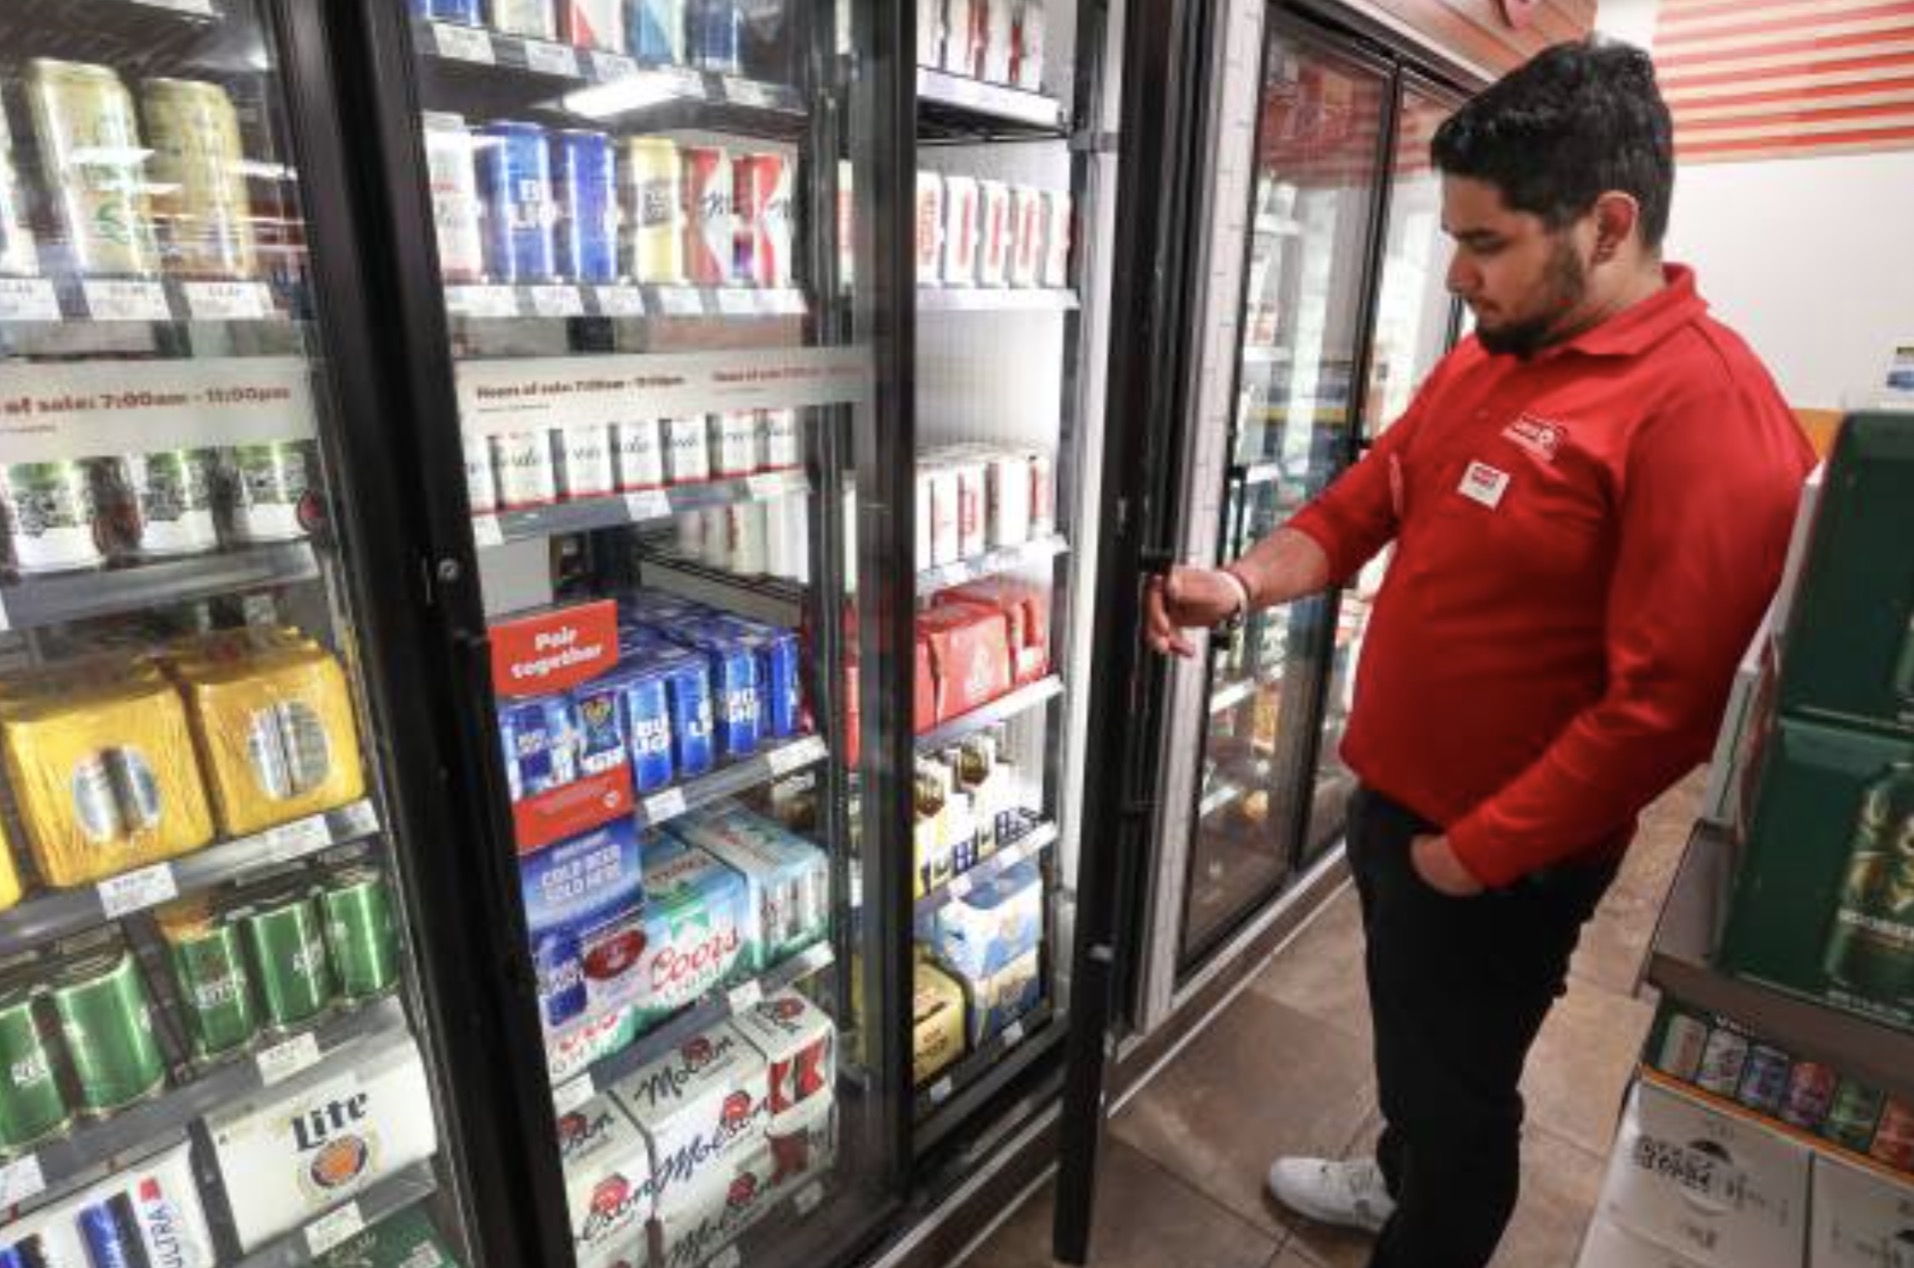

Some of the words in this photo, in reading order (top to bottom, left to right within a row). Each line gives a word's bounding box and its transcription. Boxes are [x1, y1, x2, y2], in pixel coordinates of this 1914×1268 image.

[38, 395, 95, 412] sale:
[99, 392, 188, 409] 7:00am
[206, 386, 291, 402] 11:00pm
[534, 626, 578, 652] Pair
[510, 642, 602, 679] together
[650, 927, 738, 993] Coors
[292, 1092, 368, 1152] Lite
